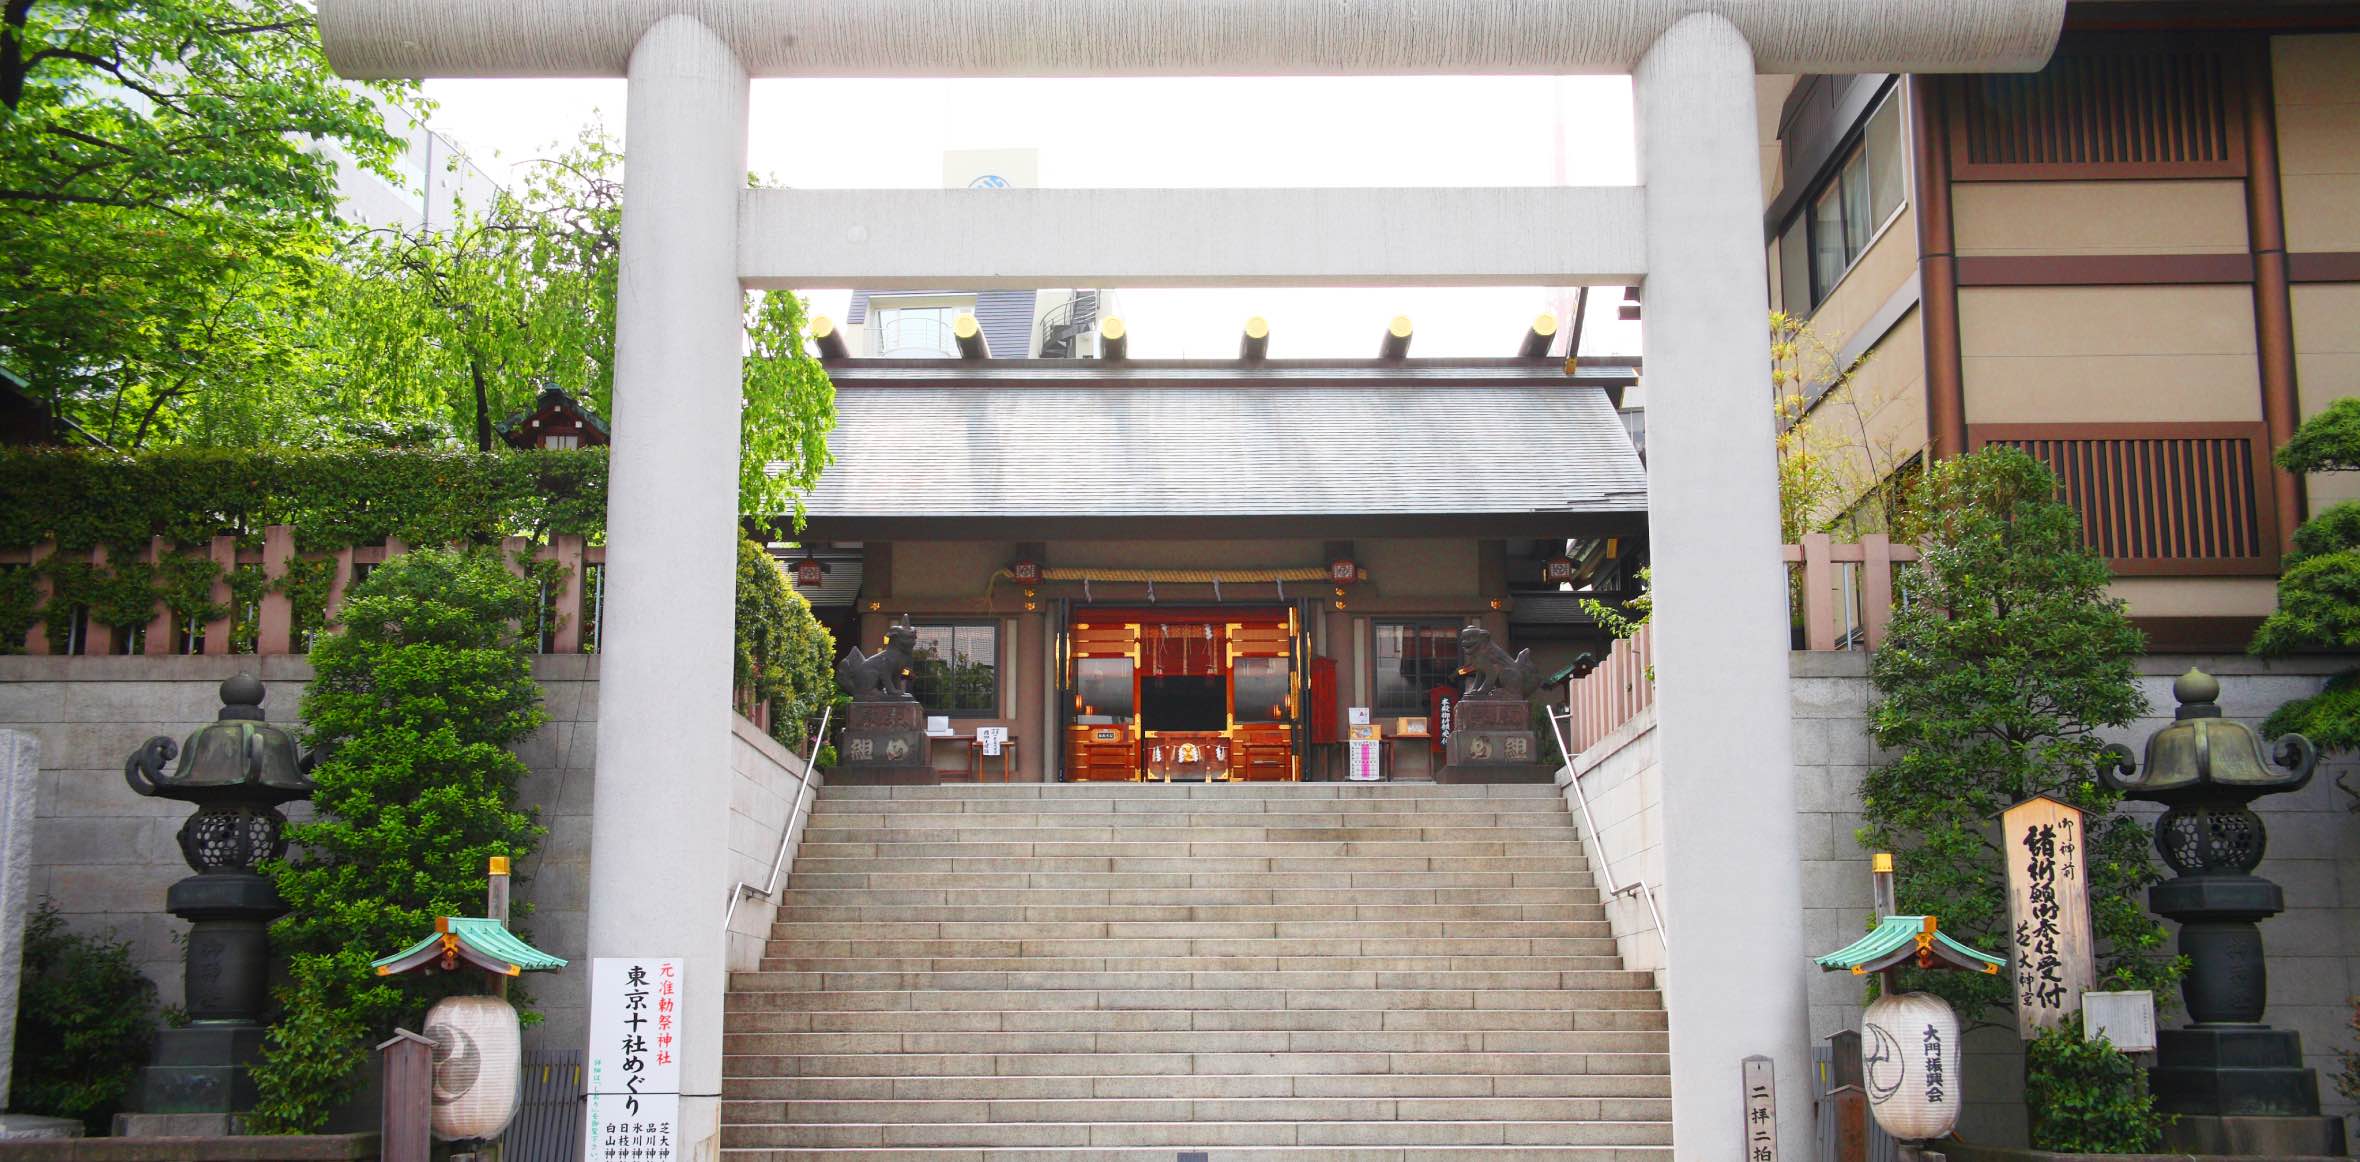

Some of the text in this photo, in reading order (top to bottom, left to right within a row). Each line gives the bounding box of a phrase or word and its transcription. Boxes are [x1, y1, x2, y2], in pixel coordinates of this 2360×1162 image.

[2058, 818, 2075, 880] 御神前
[2016, 919, 2034, 1006] 芝大神宮
[621, 966, 650, 1116] 東京十社めぐり
[1923, 1023, 1944, 1102] 大門振興会
[604, 1122, 616, 1162] 白山神
[618, 1123, 630, 1162] 日枝神
[632, 1122, 643, 1162] 氷川神
[645, 1122, 657, 1162] 品川神
[659, 1122, 670, 1162] 芝大神
